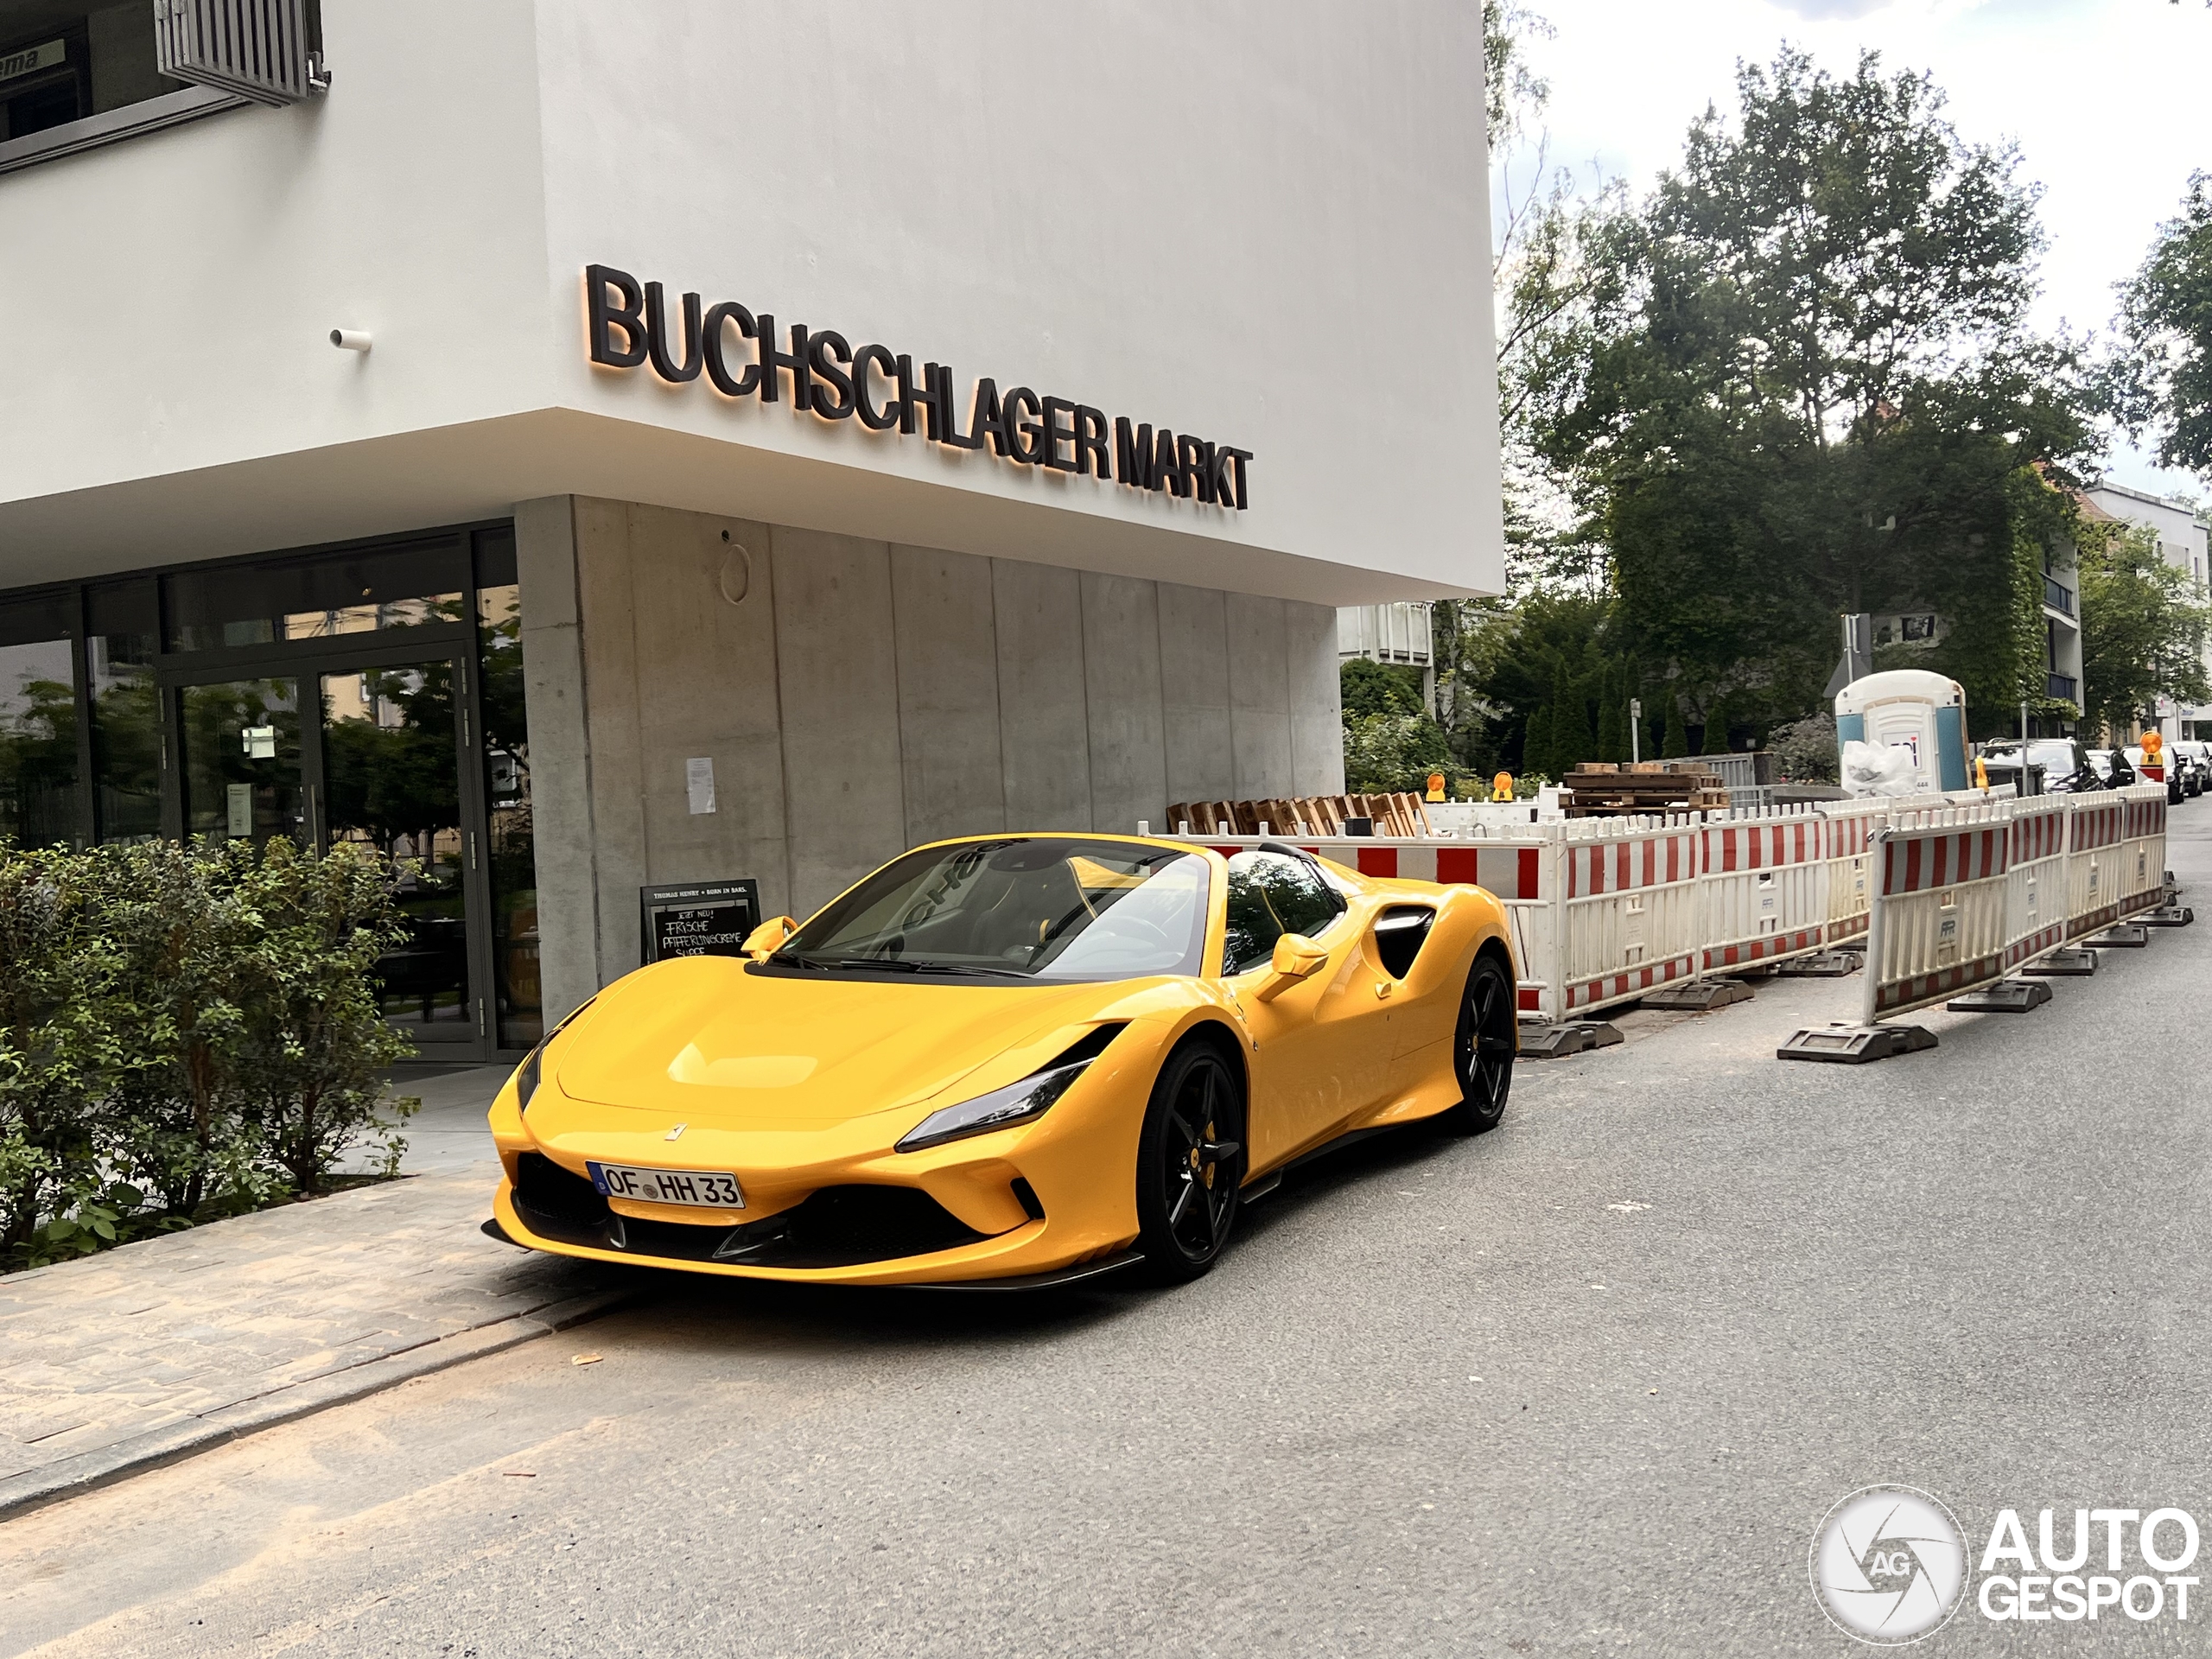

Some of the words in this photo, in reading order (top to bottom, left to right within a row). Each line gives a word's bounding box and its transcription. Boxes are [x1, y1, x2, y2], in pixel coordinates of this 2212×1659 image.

[0, 50, 39, 77] ma
[586, 264, 1111, 480] BUCHSCHLAGER
[1115, 416, 1254, 511] MARKT
[696, 910, 714, 919] NEU!
[606, 1169, 639, 1196] OF
[655, 1174, 699, 1202] HH
[698, 1177, 739, 1204] 33
